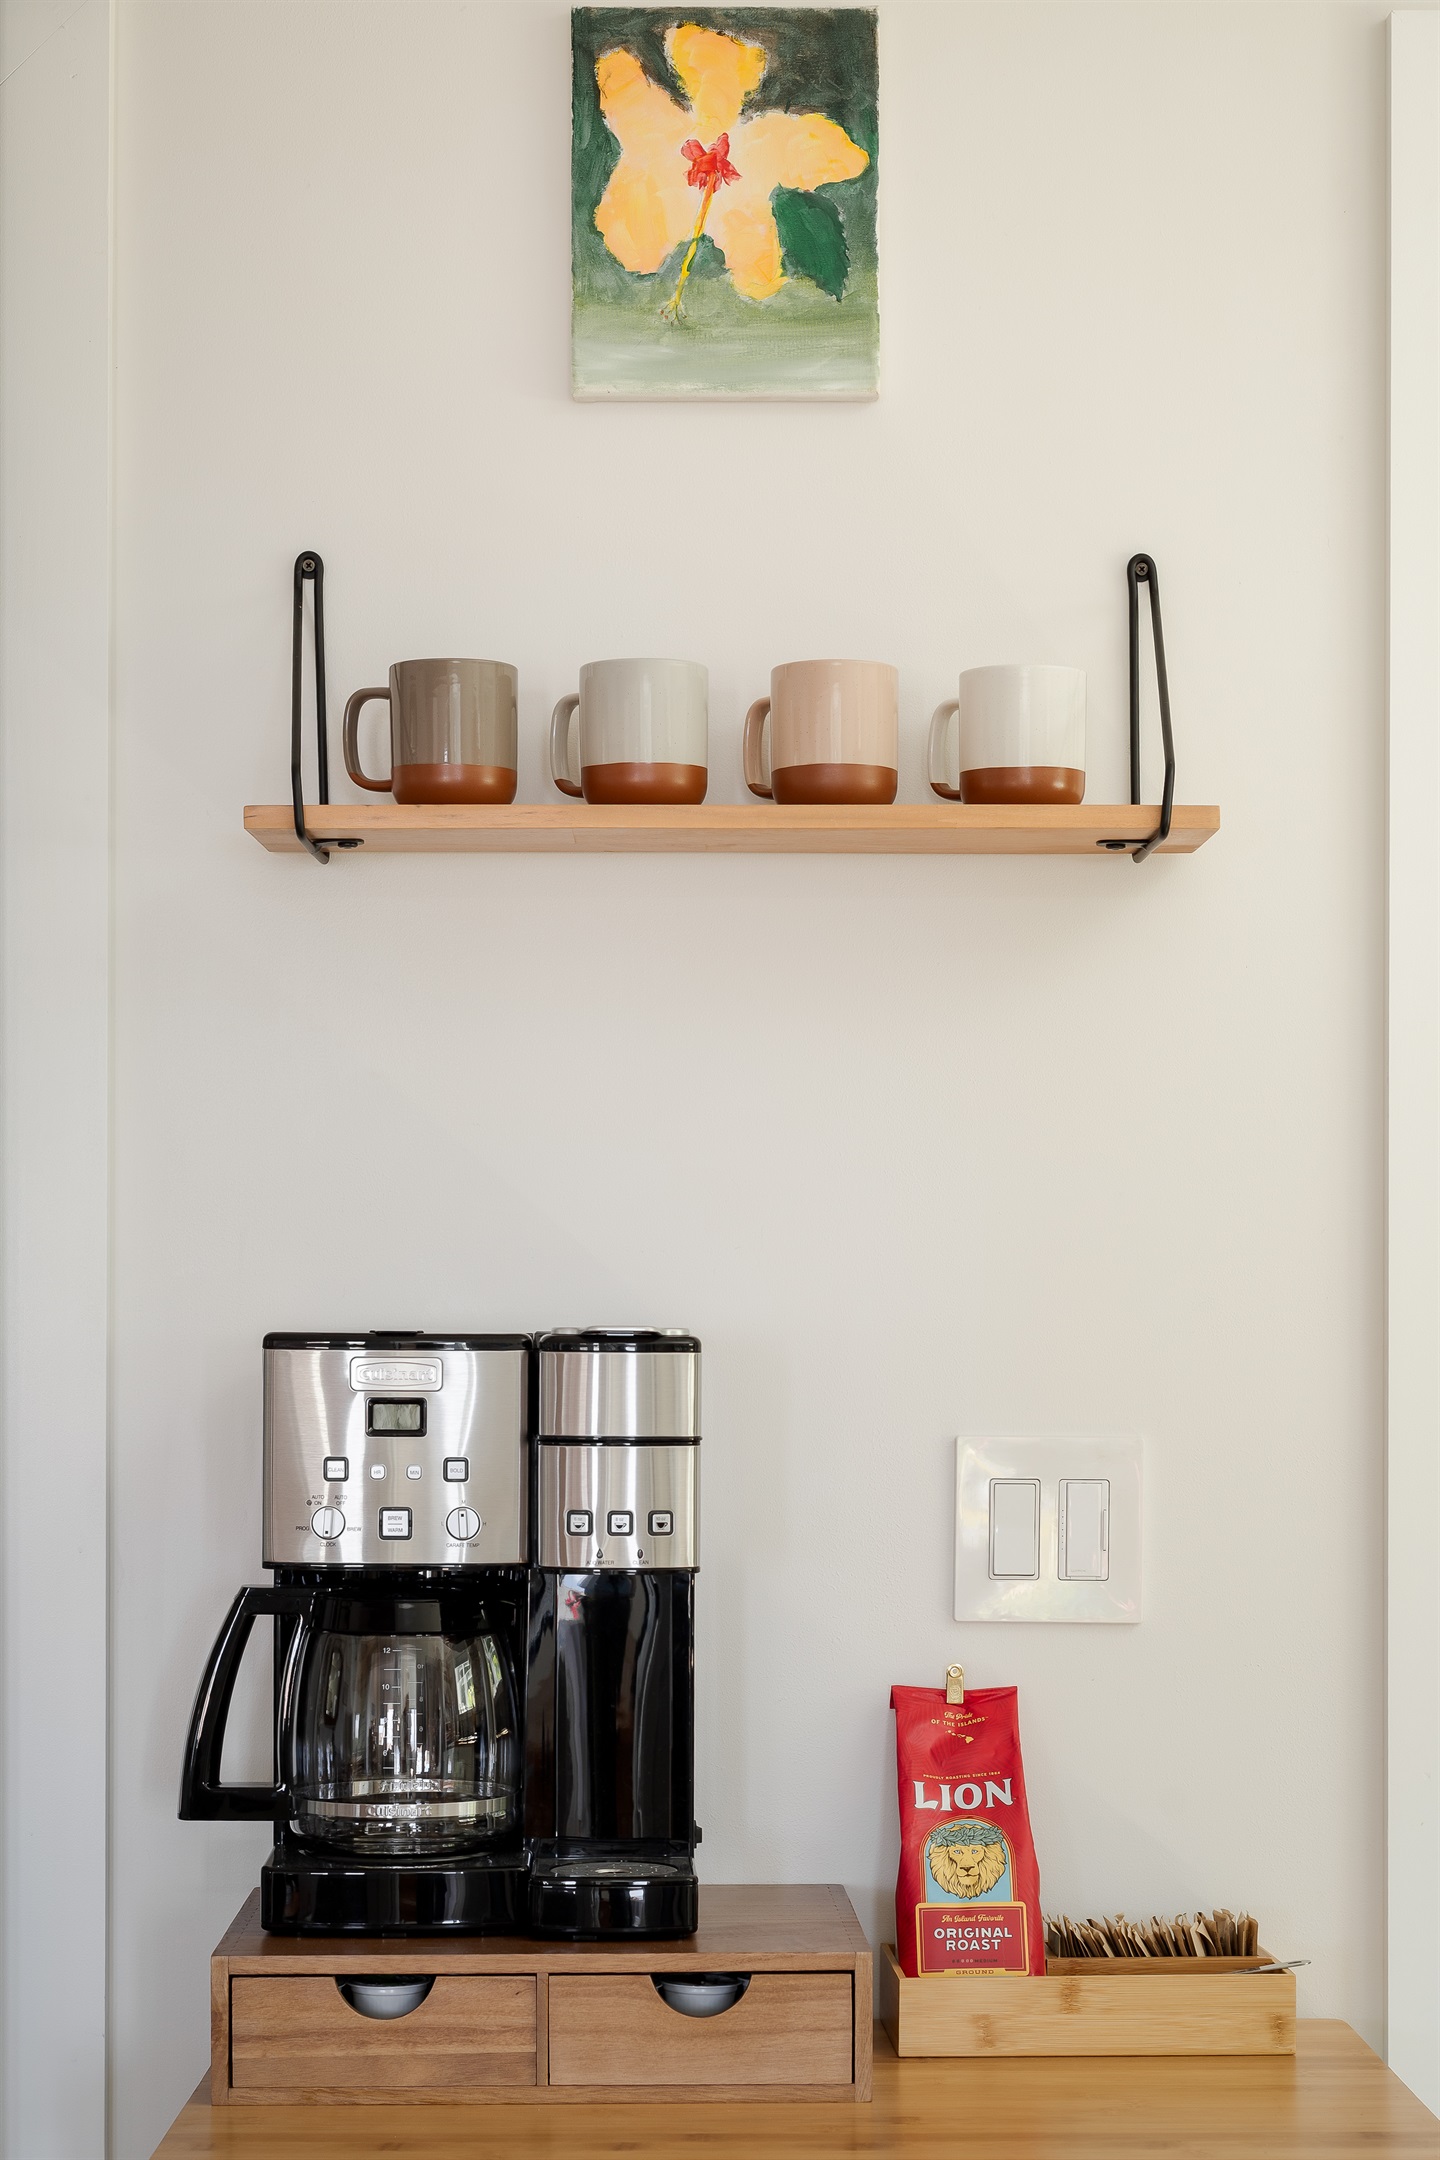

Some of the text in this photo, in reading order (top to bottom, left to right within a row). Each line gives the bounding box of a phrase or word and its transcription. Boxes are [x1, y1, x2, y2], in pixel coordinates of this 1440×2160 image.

[360, 1367, 435, 1382] Cuisinart
[381, 1683, 390, 1691] 10
[957, 1716, 986, 1727] ISLANDS
[912, 1777, 1014, 1812] LION
[366, 1804, 432, 1817] Cuisinart
[941, 1913, 1005, 1923] An Island Favorite
[933, 1927, 1013, 1939] ORIGINAL
[946, 1939, 1001, 1951] ROAST
